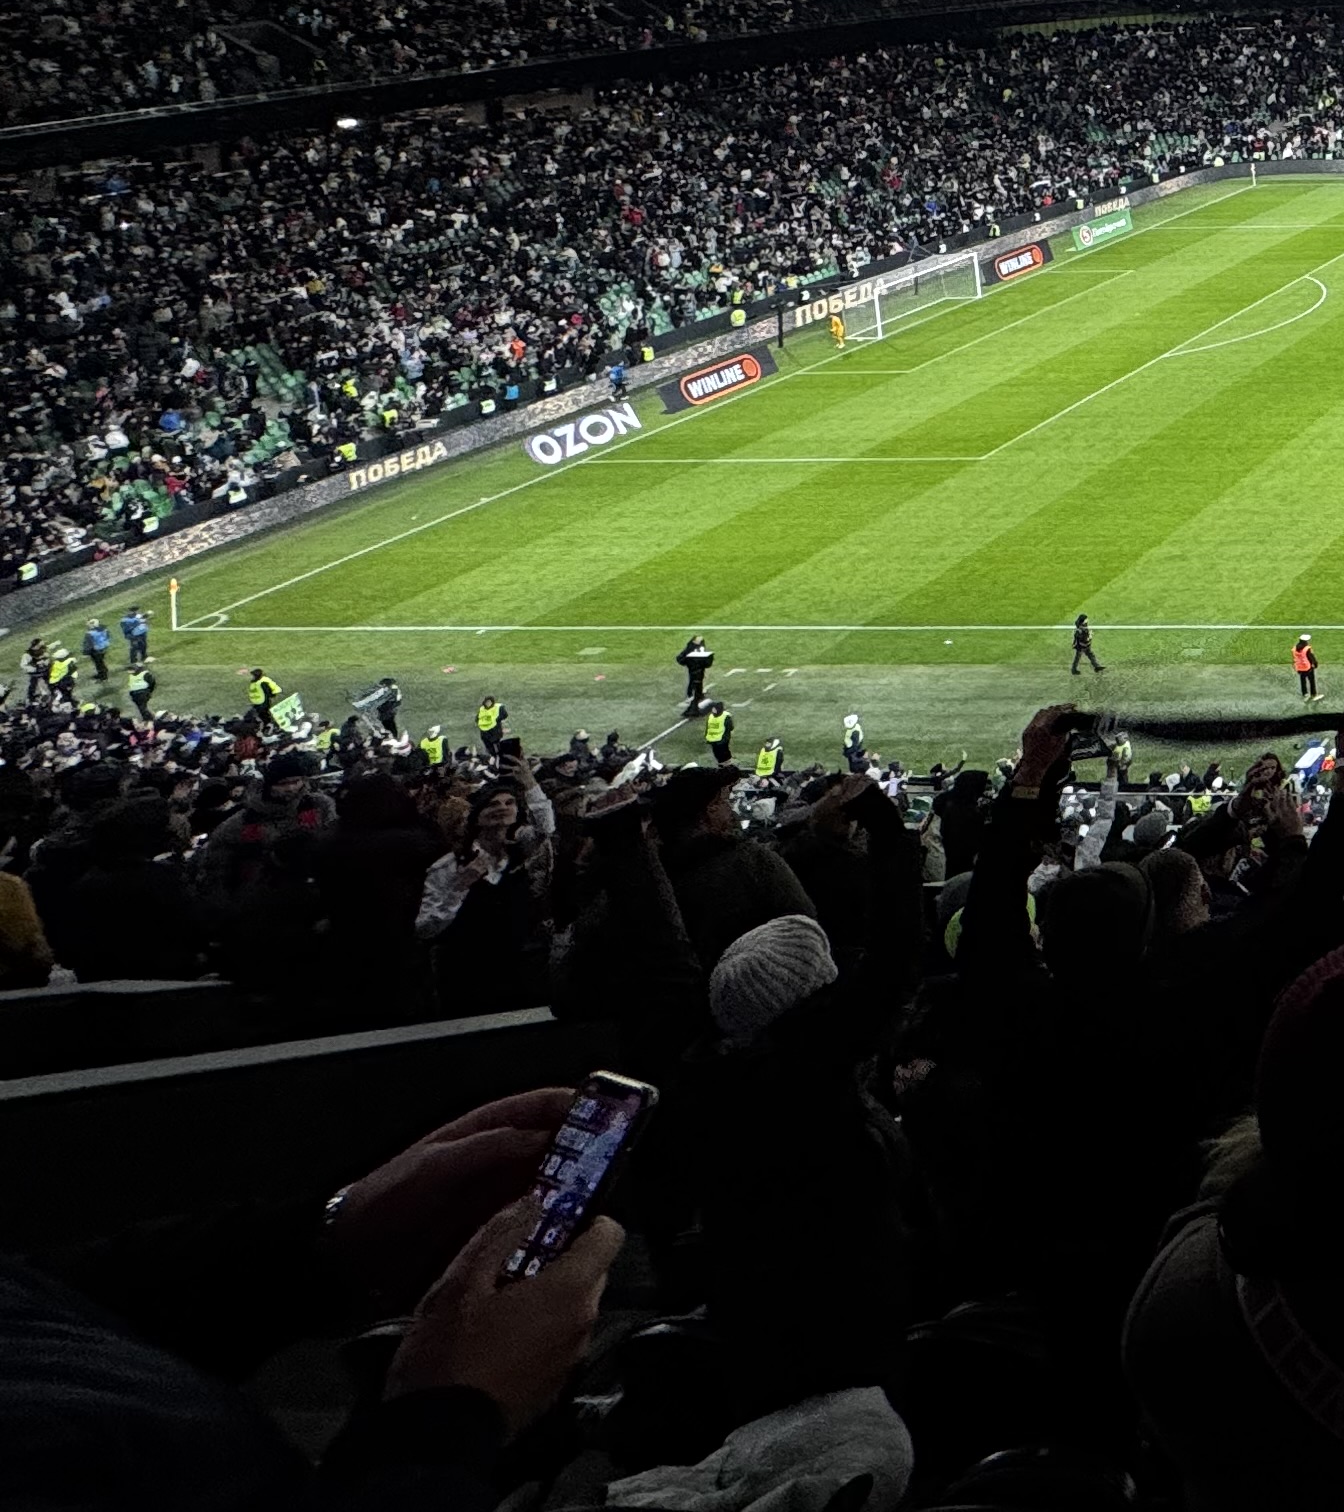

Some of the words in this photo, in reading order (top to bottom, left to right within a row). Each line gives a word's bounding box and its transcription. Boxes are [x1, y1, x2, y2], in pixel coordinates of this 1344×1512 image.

[687, 363, 745, 398] WINLINE
[531, 402, 641, 465] OZON
[348, 440, 447, 490] ПОБЕДА
